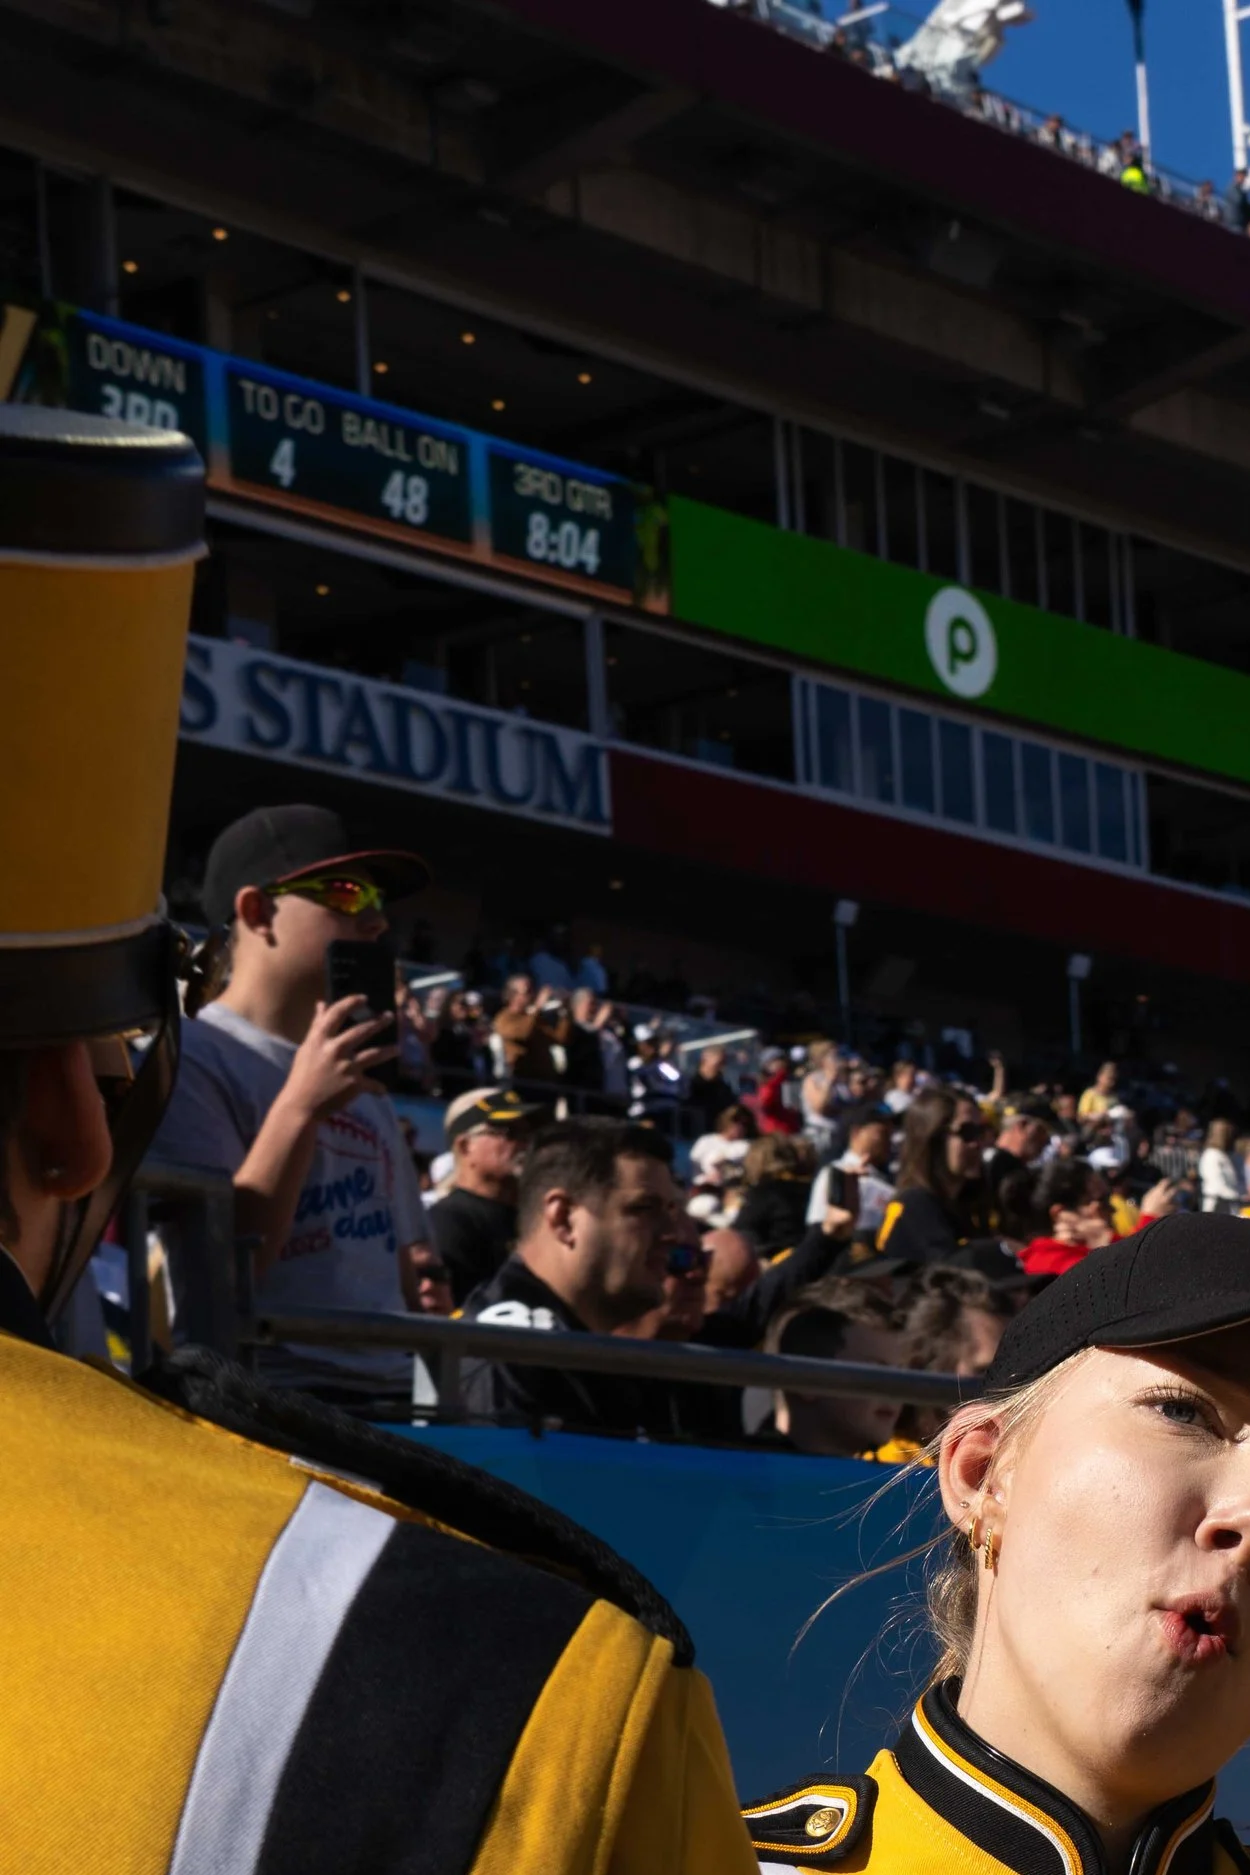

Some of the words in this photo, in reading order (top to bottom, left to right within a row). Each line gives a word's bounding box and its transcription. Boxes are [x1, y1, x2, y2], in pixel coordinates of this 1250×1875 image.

[86, 334, 185, 394] DOWN
[239, 379, 278, 421] TO
[283, 394, 325, 435] GO
[270, 437, 296, 487] 4
[342, 410, 411, 462] BALL
[417, 435, 459, 476] ON
[381, 470, 429, 525] 48
[514, 463, 562, 505] 3RD
[565, 479, 613, 521] QTR
[527, 512, 600, 575] 8:04
[241, 657, 613, 826] STADIUM
[334, 1203, 397, 1253] day
